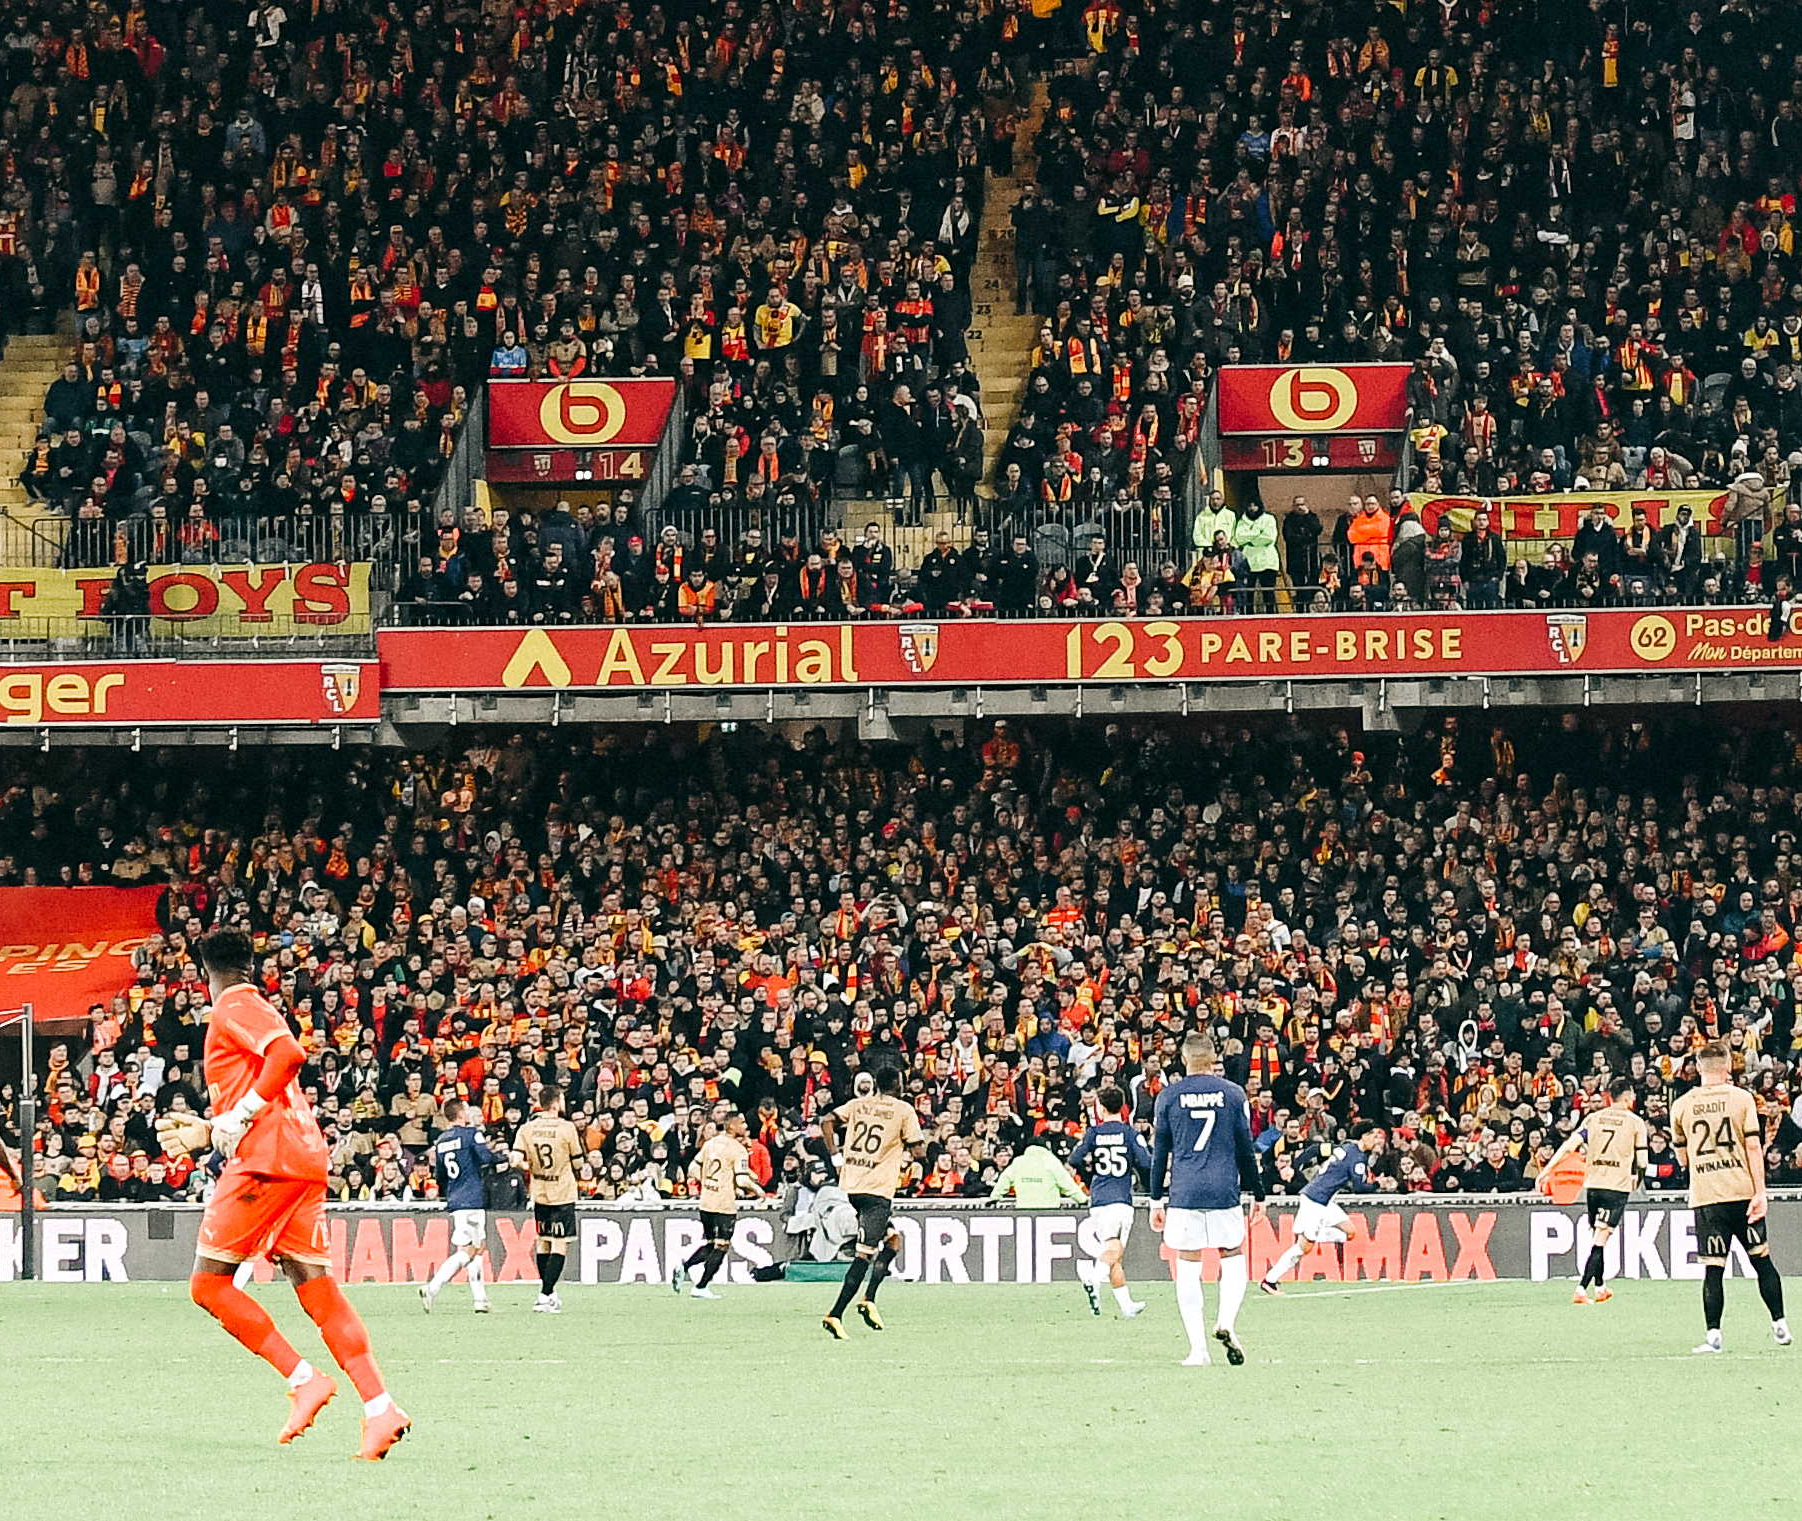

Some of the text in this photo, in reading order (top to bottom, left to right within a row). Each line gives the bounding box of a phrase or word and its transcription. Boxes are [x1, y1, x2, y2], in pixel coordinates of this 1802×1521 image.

[599, 451, 644, 480] 1.4
[1261, 439, 1304, 468] 1.3
[1066, 622, 1463, 679] 123 PARE-BRISE
[1637, 627, 1669, 648] 62
[1687, 641, 1728, 662] Mon
[596, 625, 858, 686] Azurial
[1179, 1091, 1224, 1109] MBAPPÉ
[850, 1121, 884, 1154] 26
[1189, 1110, 1216, 1152] 7
[1601, 1129, 1616, 1154] 7
[1692, 1116, 1737, 1157] 24
[443, 1152, 460, 1179] 6
[533, 1142, 553, 1170] 13
[1094, 1145, 1128, 1177] 35
